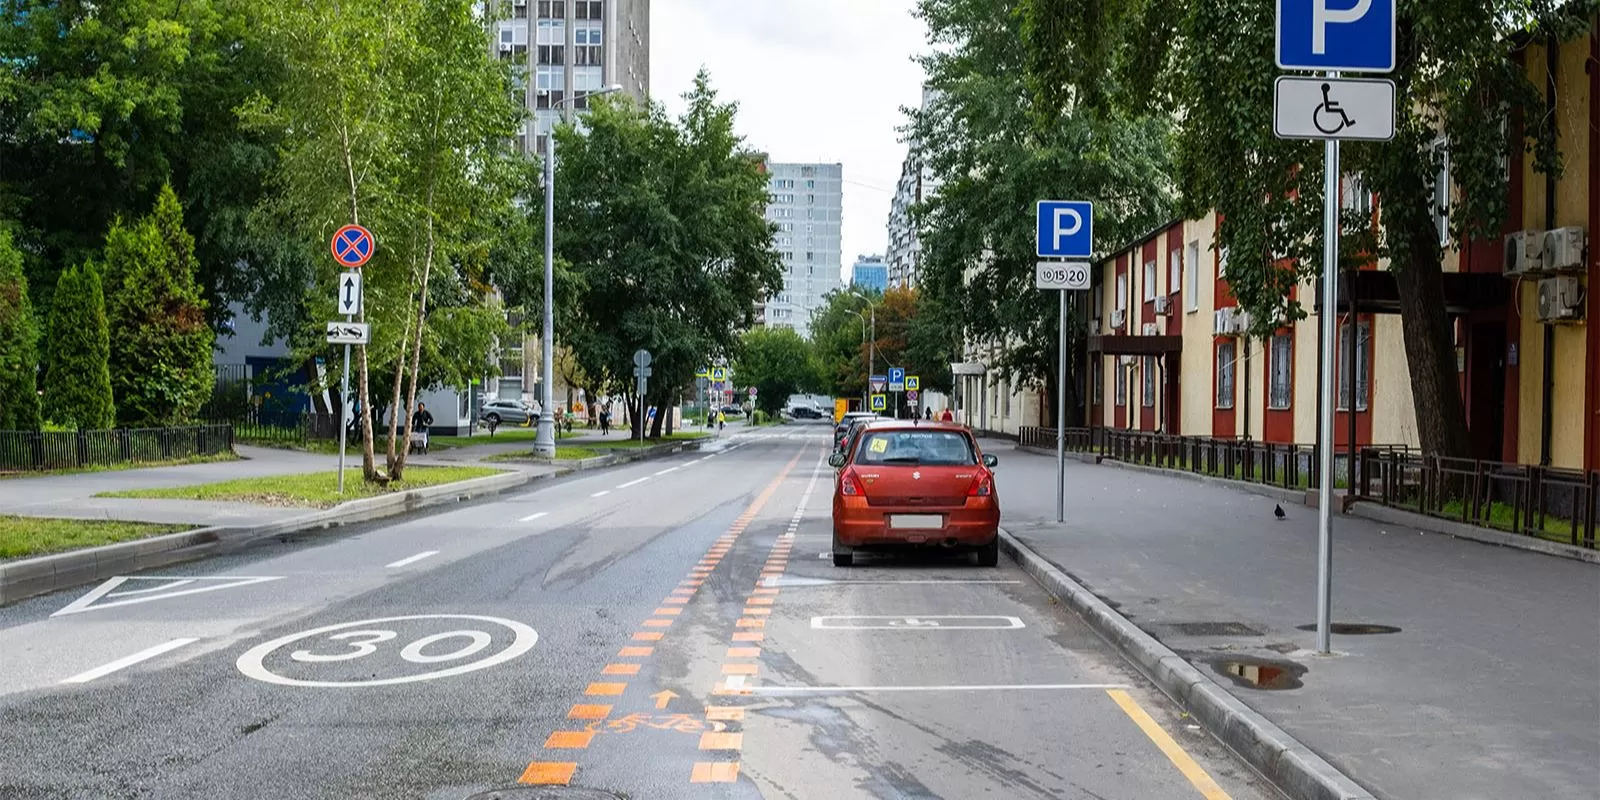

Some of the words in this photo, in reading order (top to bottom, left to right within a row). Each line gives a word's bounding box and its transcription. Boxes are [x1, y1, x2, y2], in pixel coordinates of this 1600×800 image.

[1312, 0, 1372, 54] P
[1053, 208, 1082, 250] P
[1055, 270, 1065, 280] 15
[1069, 270, 1084, 281] 20
[893, 370, 901, 382] P
[290, 629, 492, 663] 30
